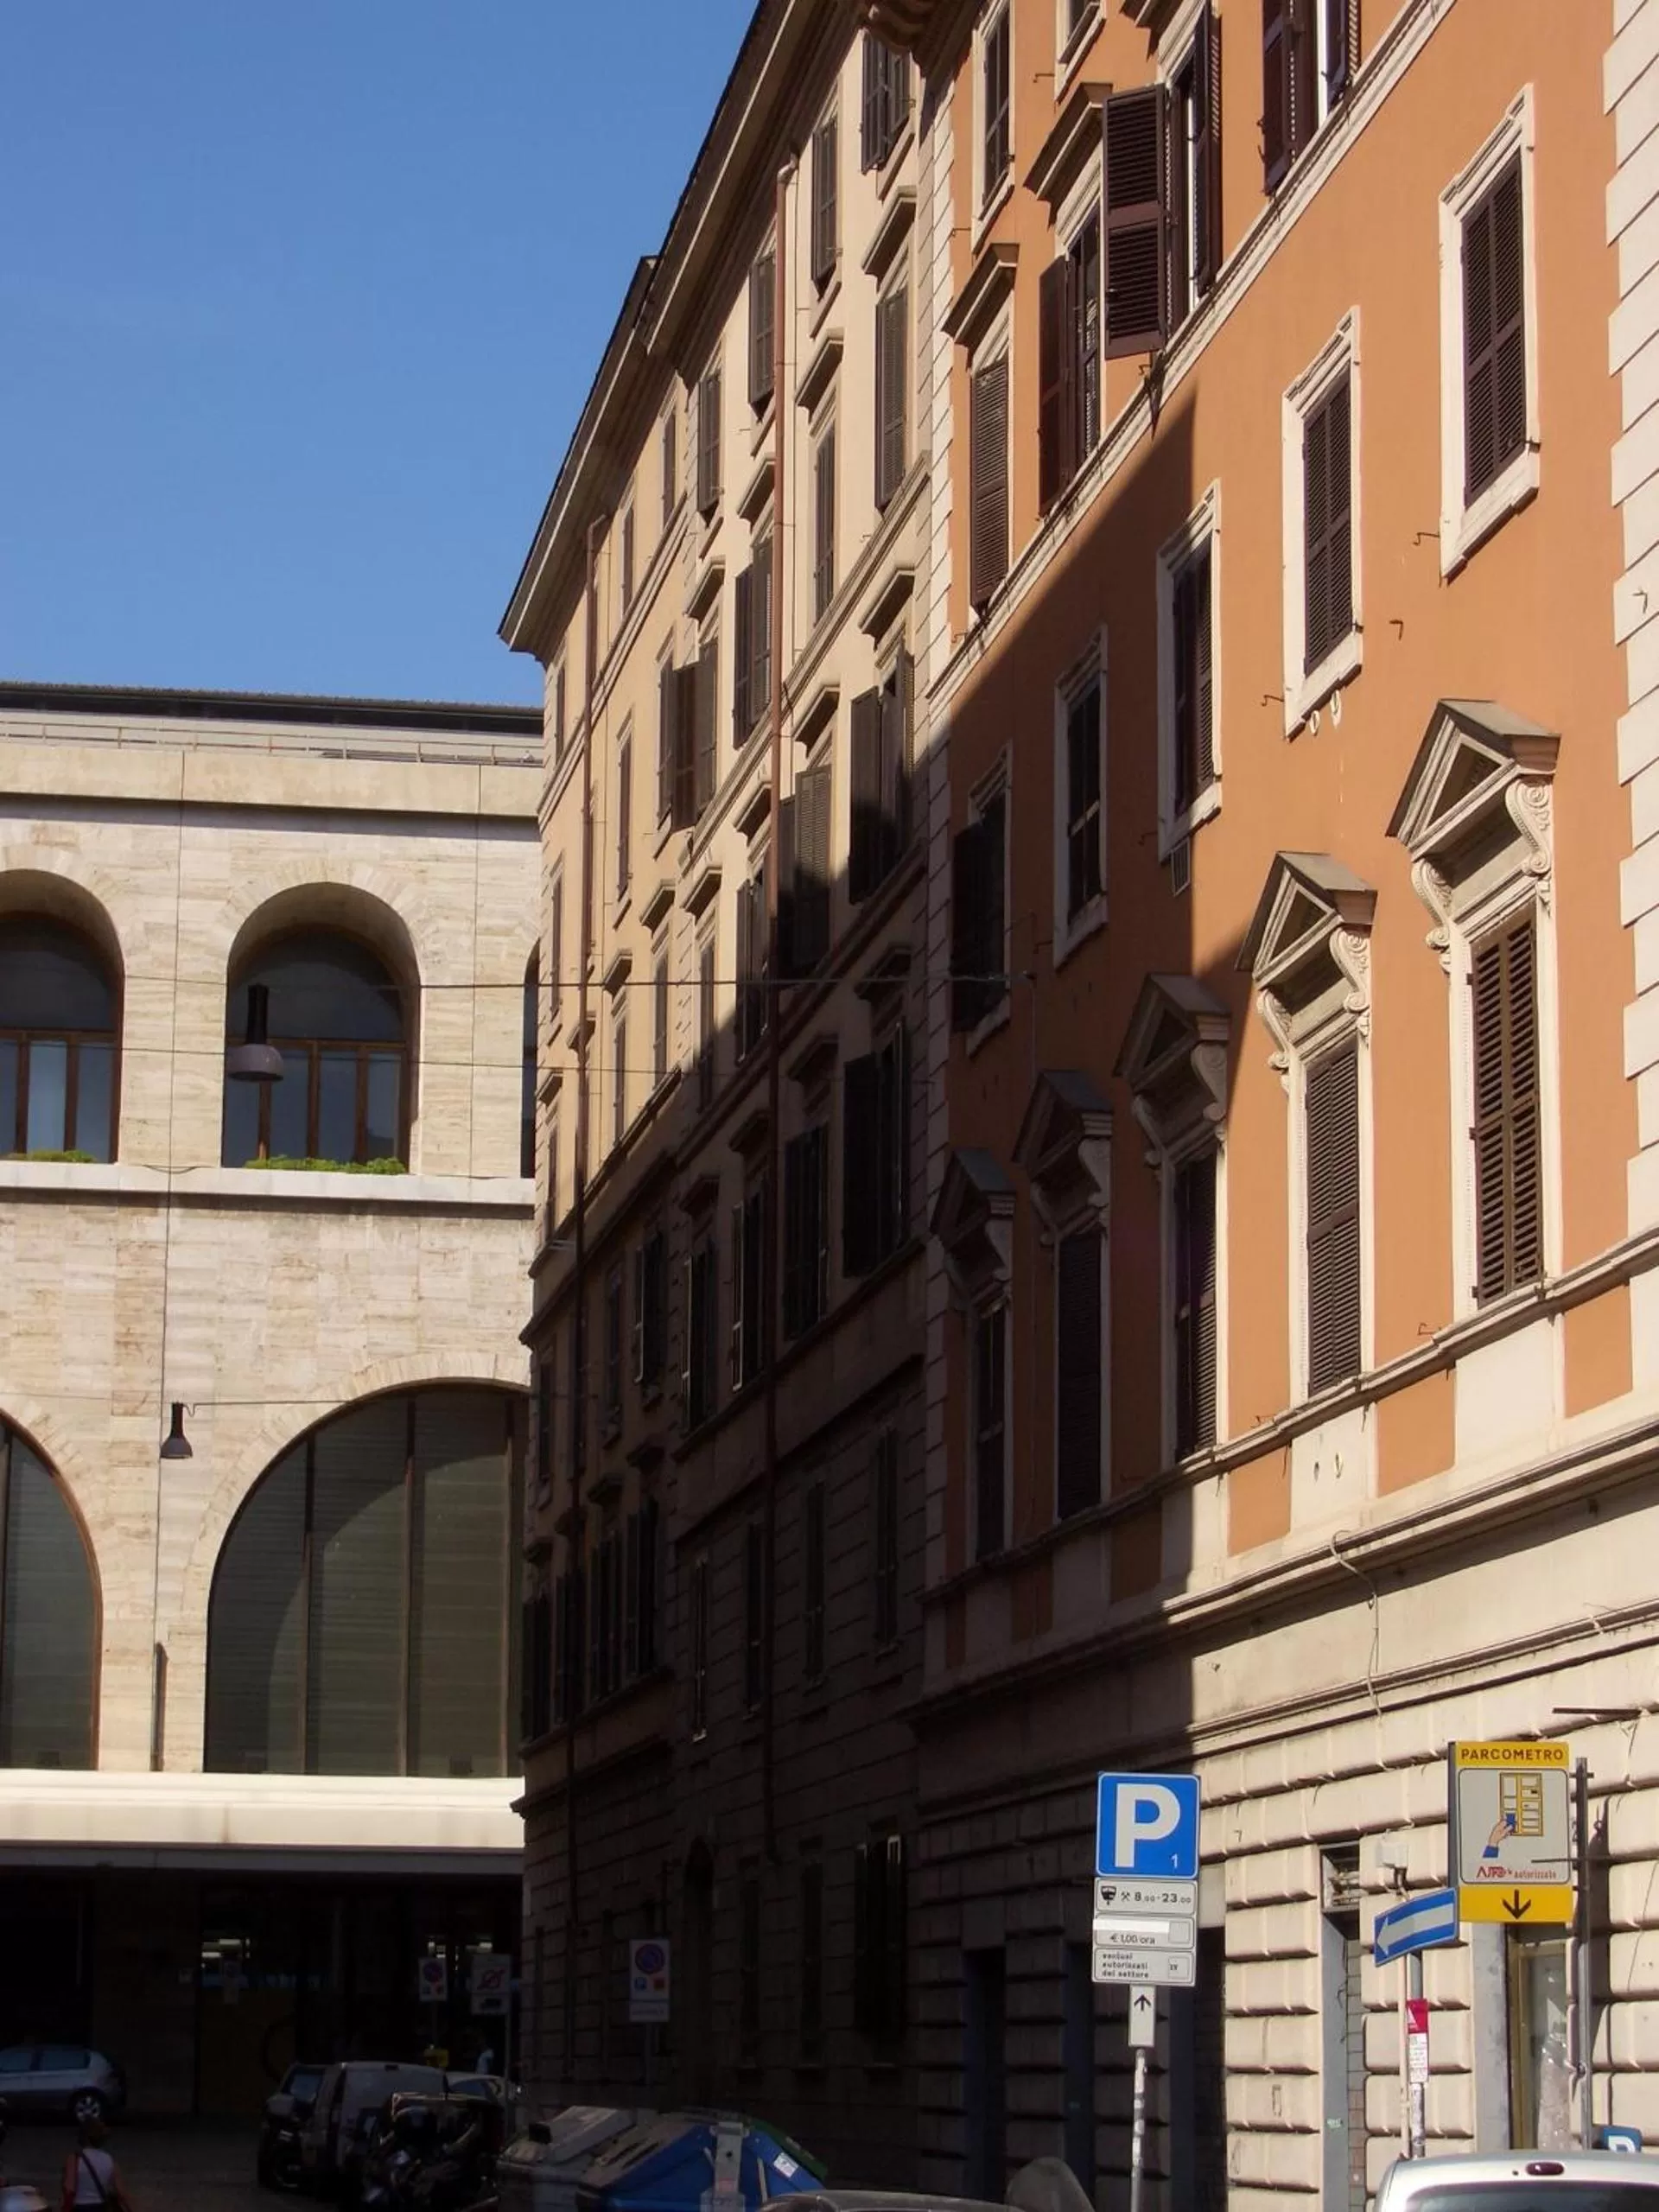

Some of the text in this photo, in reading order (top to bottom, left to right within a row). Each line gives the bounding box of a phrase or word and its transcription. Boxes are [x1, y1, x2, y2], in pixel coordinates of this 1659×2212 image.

[1460, 1748, 1564, 1761] PARCOMETRO
[1115, 1783, 1180, 1868] P
[1170, 1853, 1179, 1869] 1
